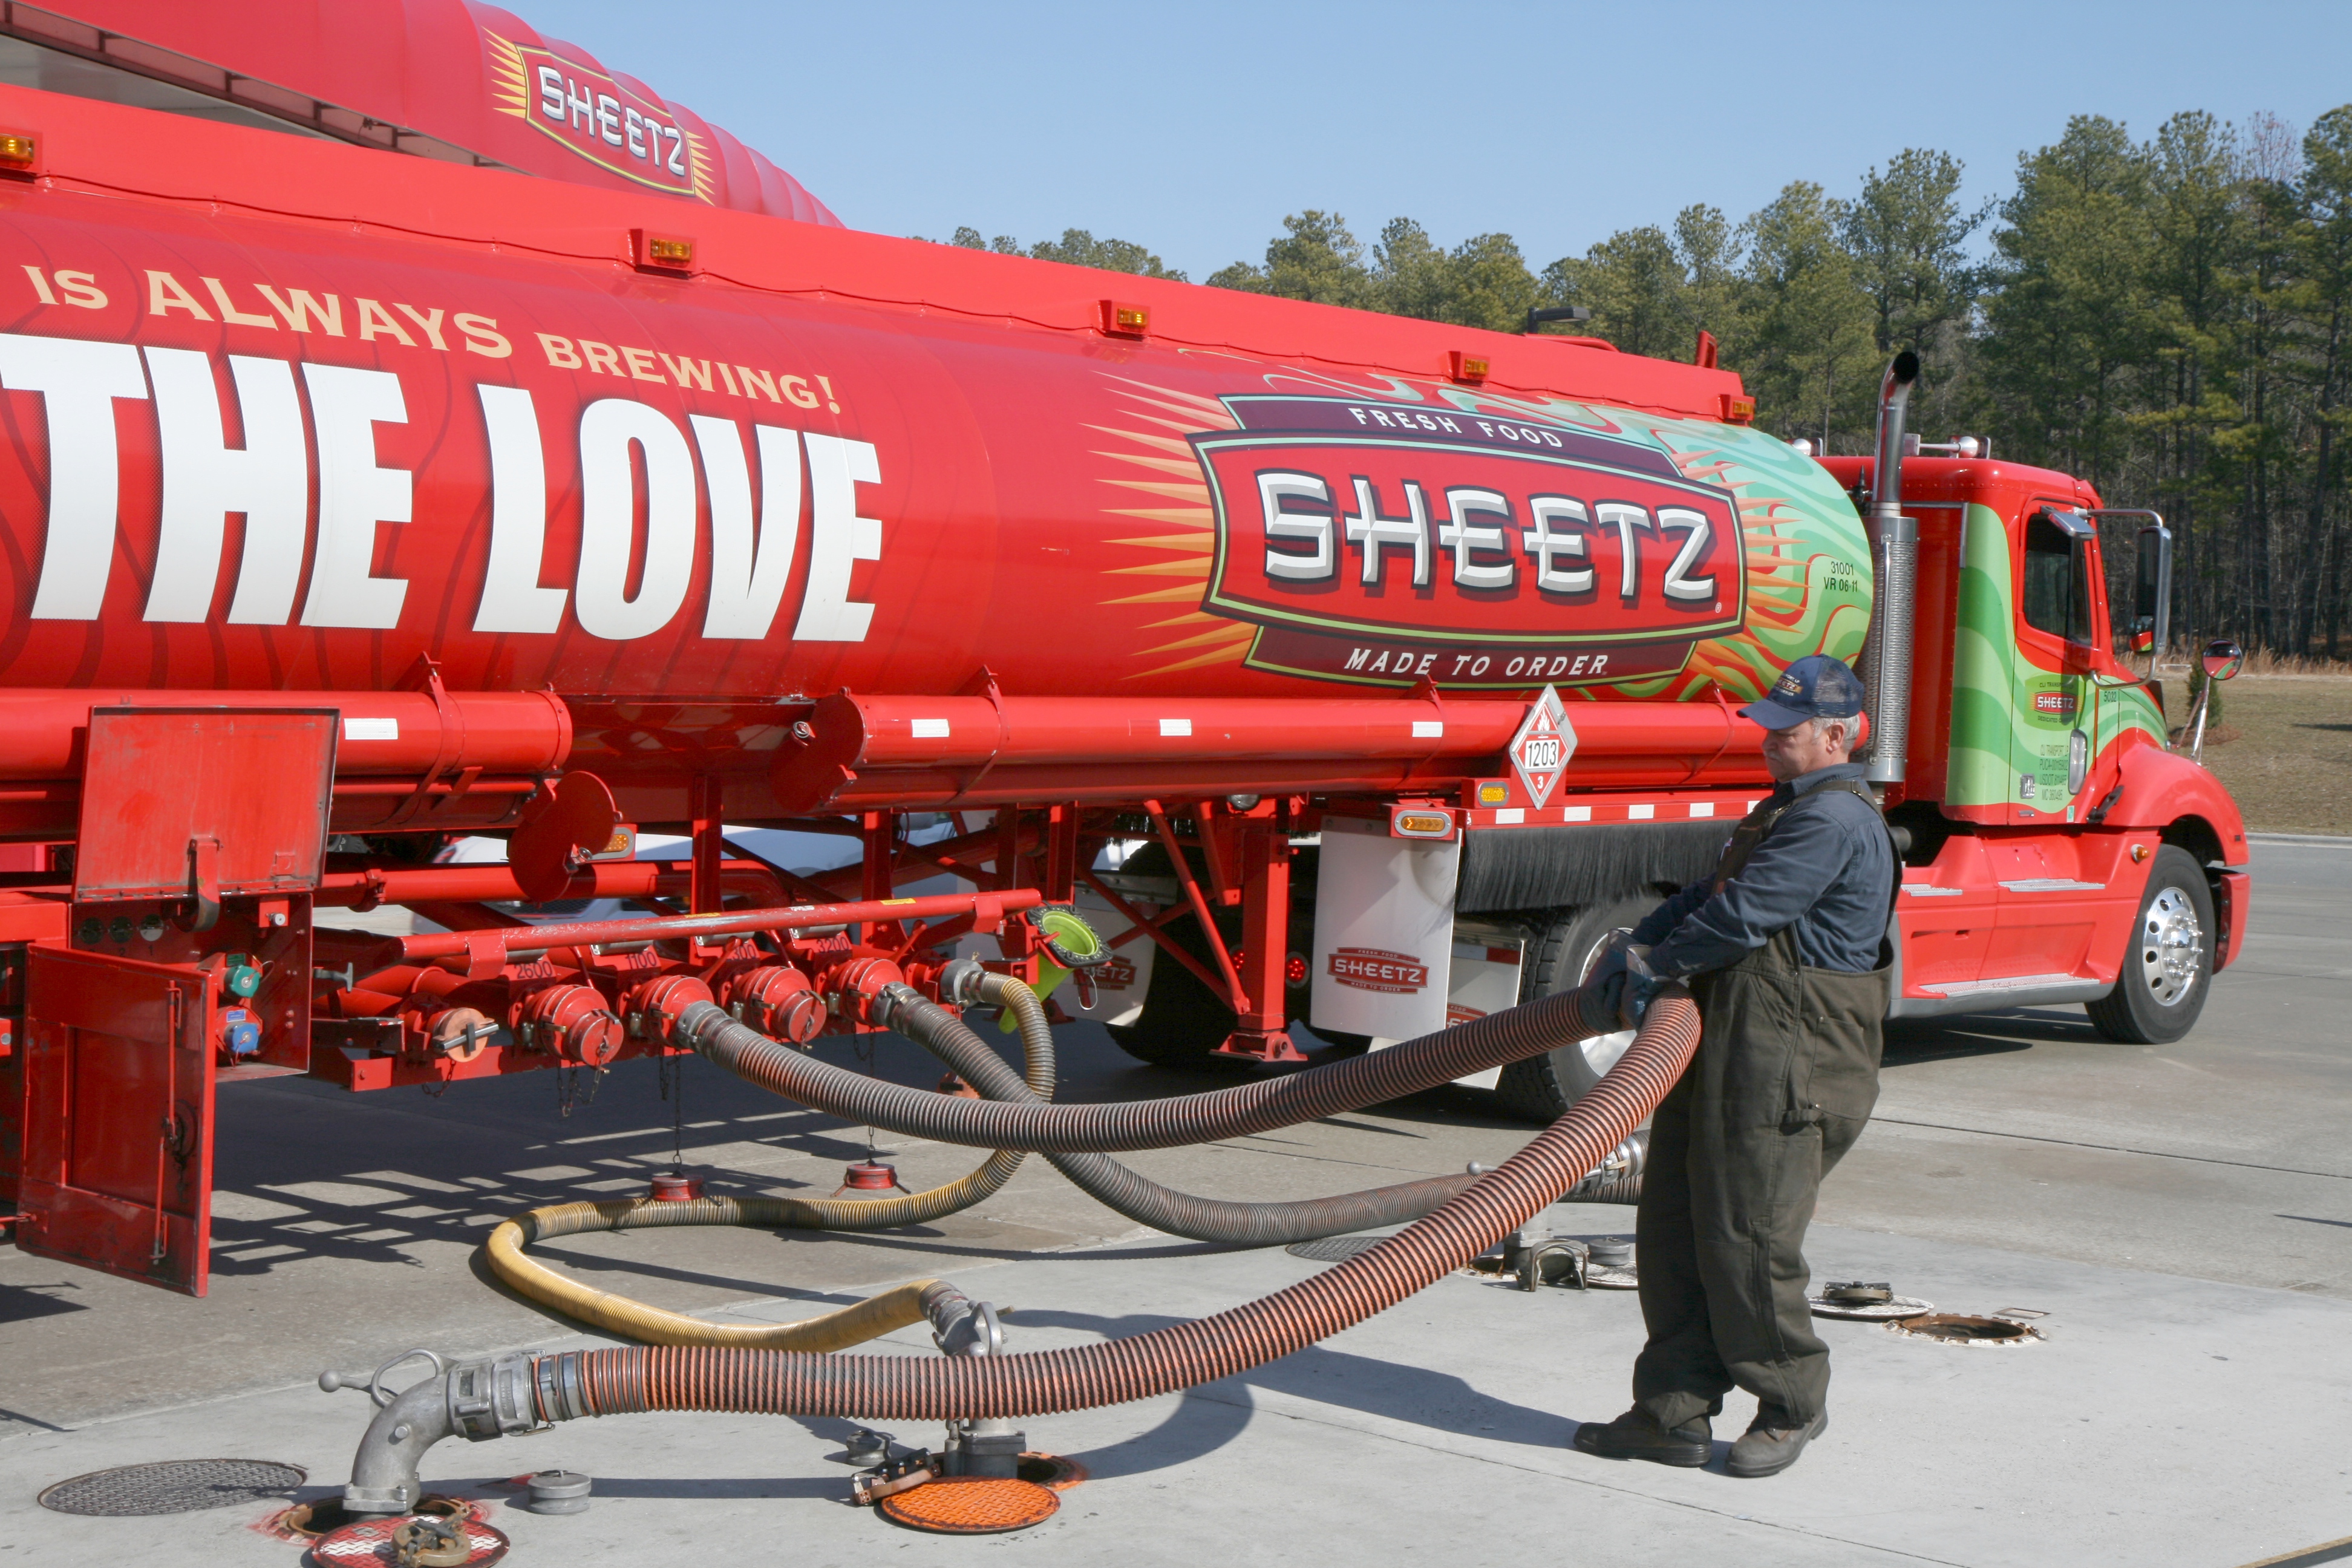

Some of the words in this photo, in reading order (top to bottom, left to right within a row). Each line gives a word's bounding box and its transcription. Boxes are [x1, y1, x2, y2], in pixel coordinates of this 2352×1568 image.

[537, 65, 685, 176] SHEETZ
[21, 265, 108, 309] IS
[143, 269, 512, 358] ALWAYS
[534, 332, 841, 414] BREWING!
[1348, 408, 1462, 434] FRESH
[1476, 421, 1563, 448] FOOD
[0, 333, 413, 629] THE
[472, 383, 882, 642] LOVE
[1255, 469, 1715, 602] SHEETZ
[1831, 561, 1854, 575] 31001
[1823, 577, 1836, 590] VR
[1344, 648, 1437, 675] MADE
[1452, 655, 1490, 676] TO
[1506, 655, 1609, 676] ORDER
[2037, 696, 2074, 708] SHEETZ
[1528, 742, 1557, 767] 1203
[1537, 776, 1544, 789] 3
[817, 936, 851, 953] 3200
[515, 961, 553, 979] 2600
[625, 951, 658, 969] 1100
[1334, 959, 1421, 983] SHEETZ
